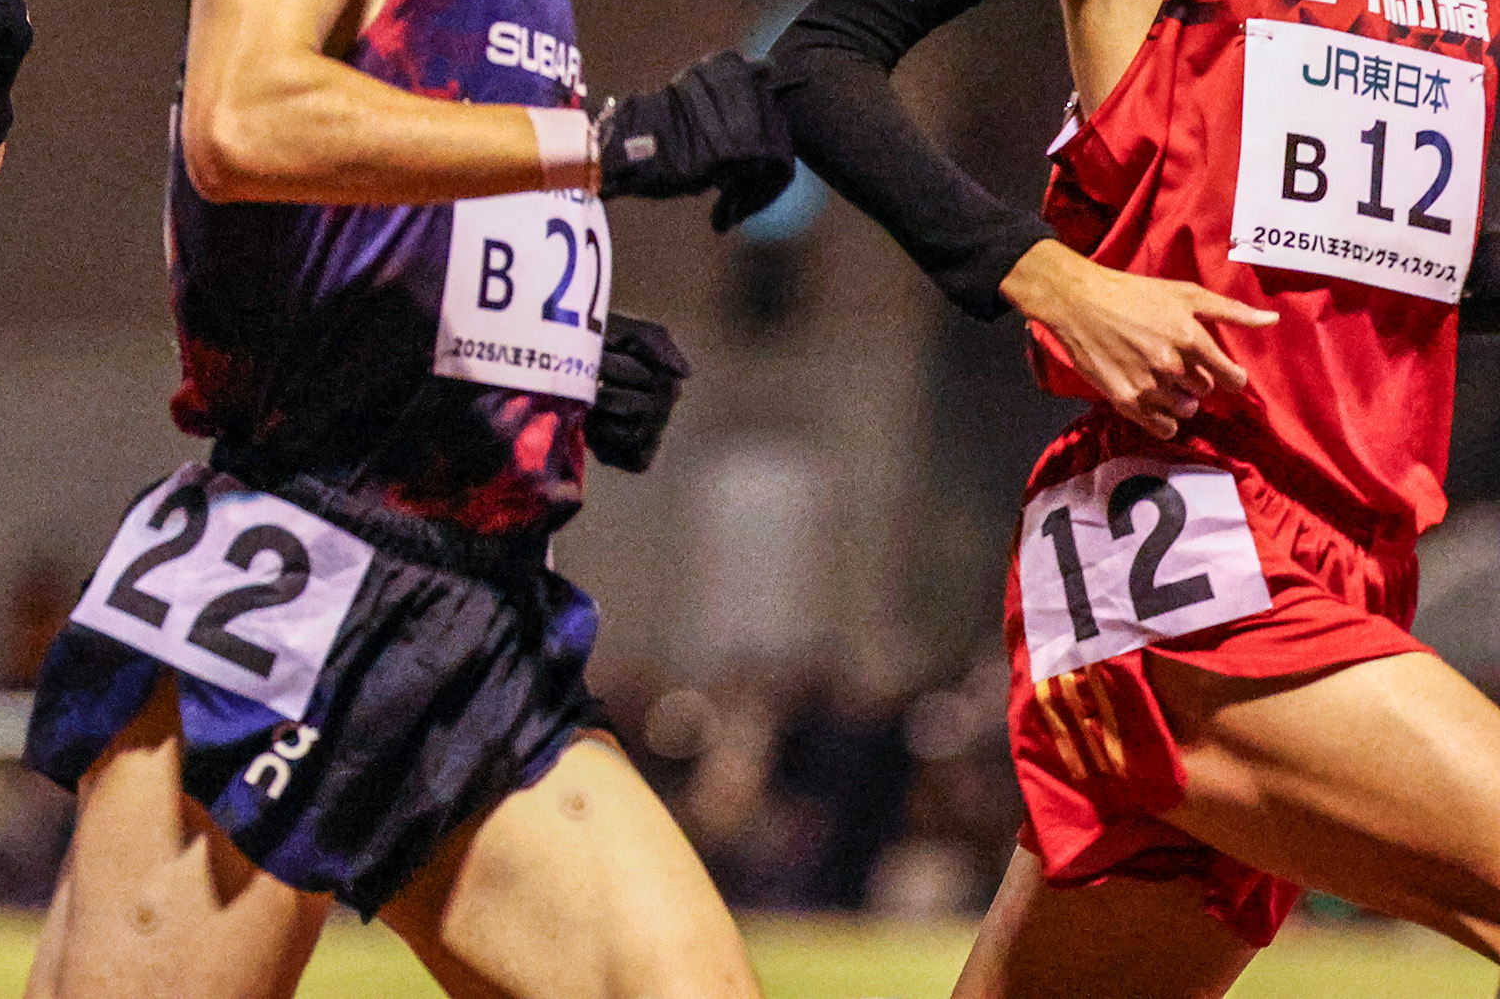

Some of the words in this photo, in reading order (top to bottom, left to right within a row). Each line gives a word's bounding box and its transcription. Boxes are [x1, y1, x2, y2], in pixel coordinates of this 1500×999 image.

[486, 21, 588, 98] SUBAR
[1303, 45, 1451, 114] JR東日本
[1281, 132, 1329, 203] B
[1356, 119, 1453, 235] 12
[477, 237, 514, 312] B
[104, 483, 312, 680] 22
[1041, 473, 1215, 643] 12
